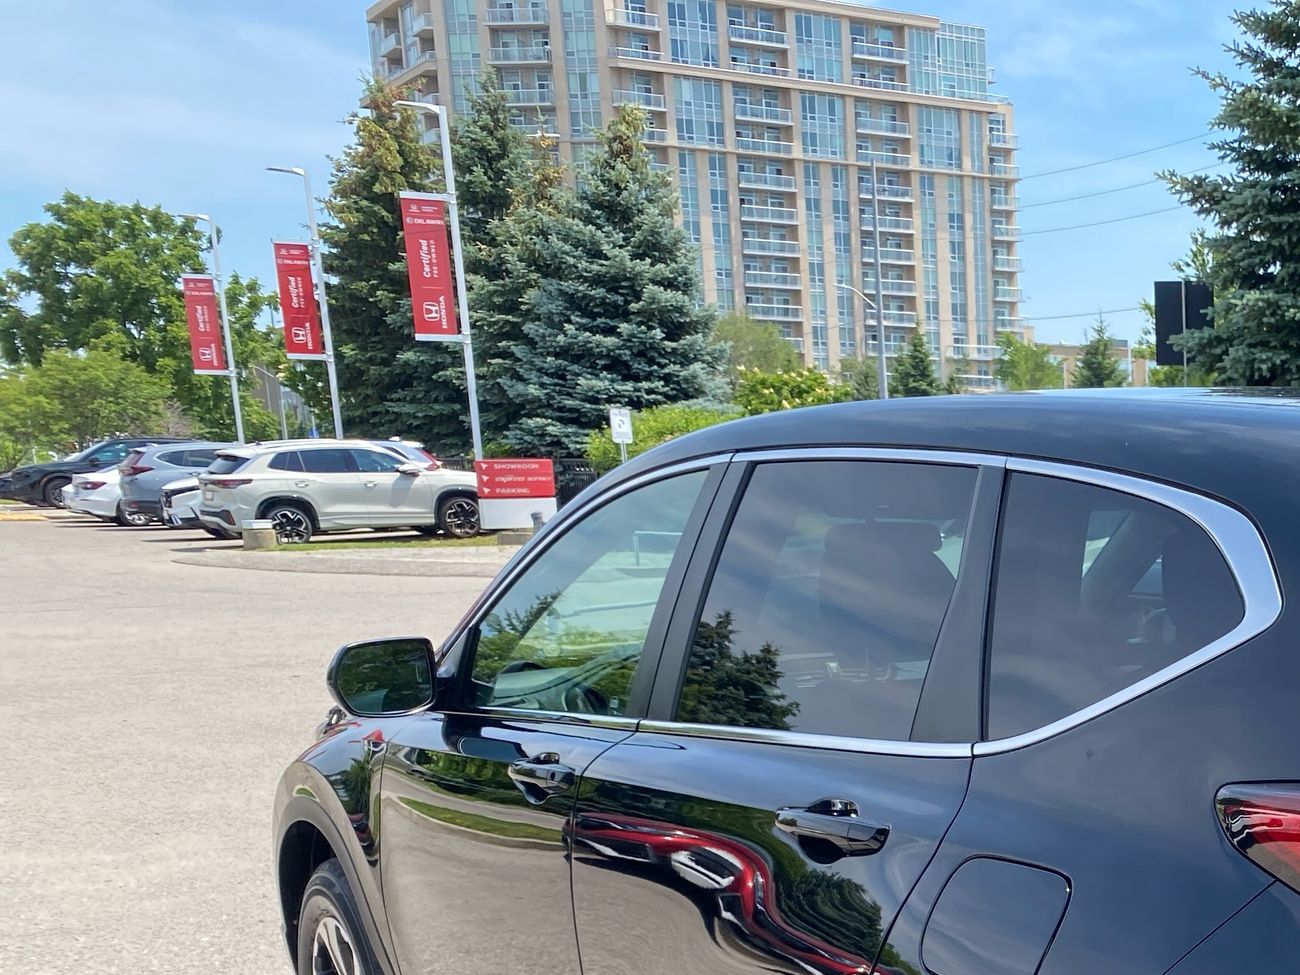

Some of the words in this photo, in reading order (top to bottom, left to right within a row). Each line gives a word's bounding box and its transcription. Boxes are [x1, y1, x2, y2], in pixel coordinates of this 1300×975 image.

[419, 239, 431, 278] Certified
[430, 240, 439, 278] PRE-OWNED
[288, 276, 299, 308] Certified
[195, 305, 205, 332] Certified
[439, 295, 448, 329] HONDA
[305, 322, 313, 350] HONDA
[495, 475, 525, 484] express
